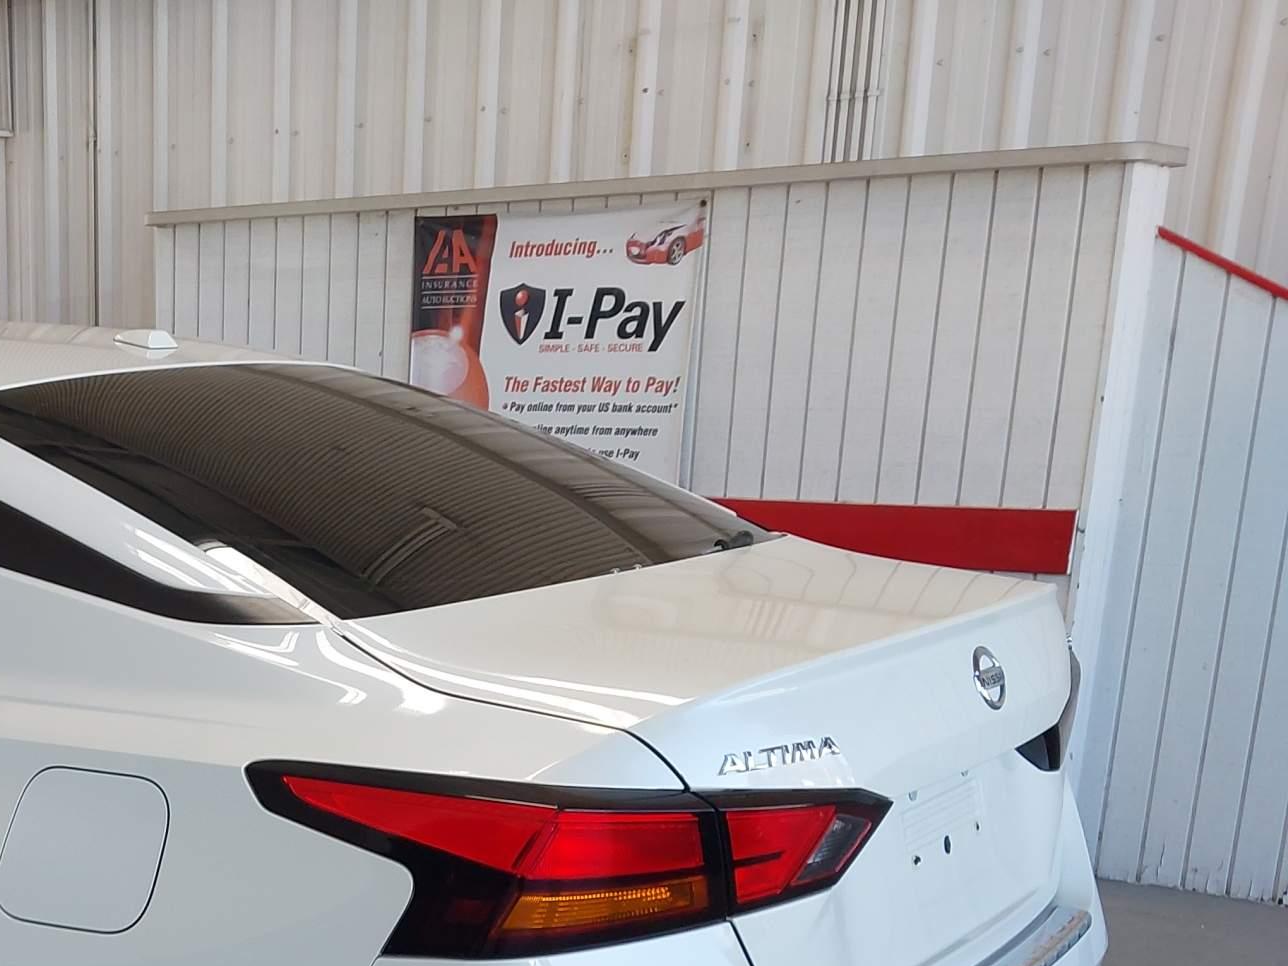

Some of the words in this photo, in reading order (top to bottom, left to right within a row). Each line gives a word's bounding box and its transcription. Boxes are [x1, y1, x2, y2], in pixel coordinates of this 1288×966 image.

[509, 237, 614, 258] Introducing...
[421, 279, 478, 289] INSURANCE
[544, 287, 687, 353] I-Pay
[538, 343, 569, 353] SIMPLE
[577, 343, 600, 353] SAFE
[607, 343, 643, 353] SECURE
[504, 376, 529, 393] The
[533, 376, 587, 393] Fastest
[591, 376, 622, 396] Way
[625, 377, 641, 393] to
[644, 376, 681, 397] Pay!
[509, 402, 526, 414] Pay
[527, 402, 553, 413] online
[555, 402, 575, 413] from
[576, 403, 597, 415] your
[598, 403, 610, 413] US
[612, 403, 633, 413] bank
[555, 424, 589, 437] anytime
[592, 425, 613, 436] from
[614, 426, 658, 437] anywhere
[615, 448, 641, 461] I-Pay
[717, 735, 841, 776] ALTIMA
